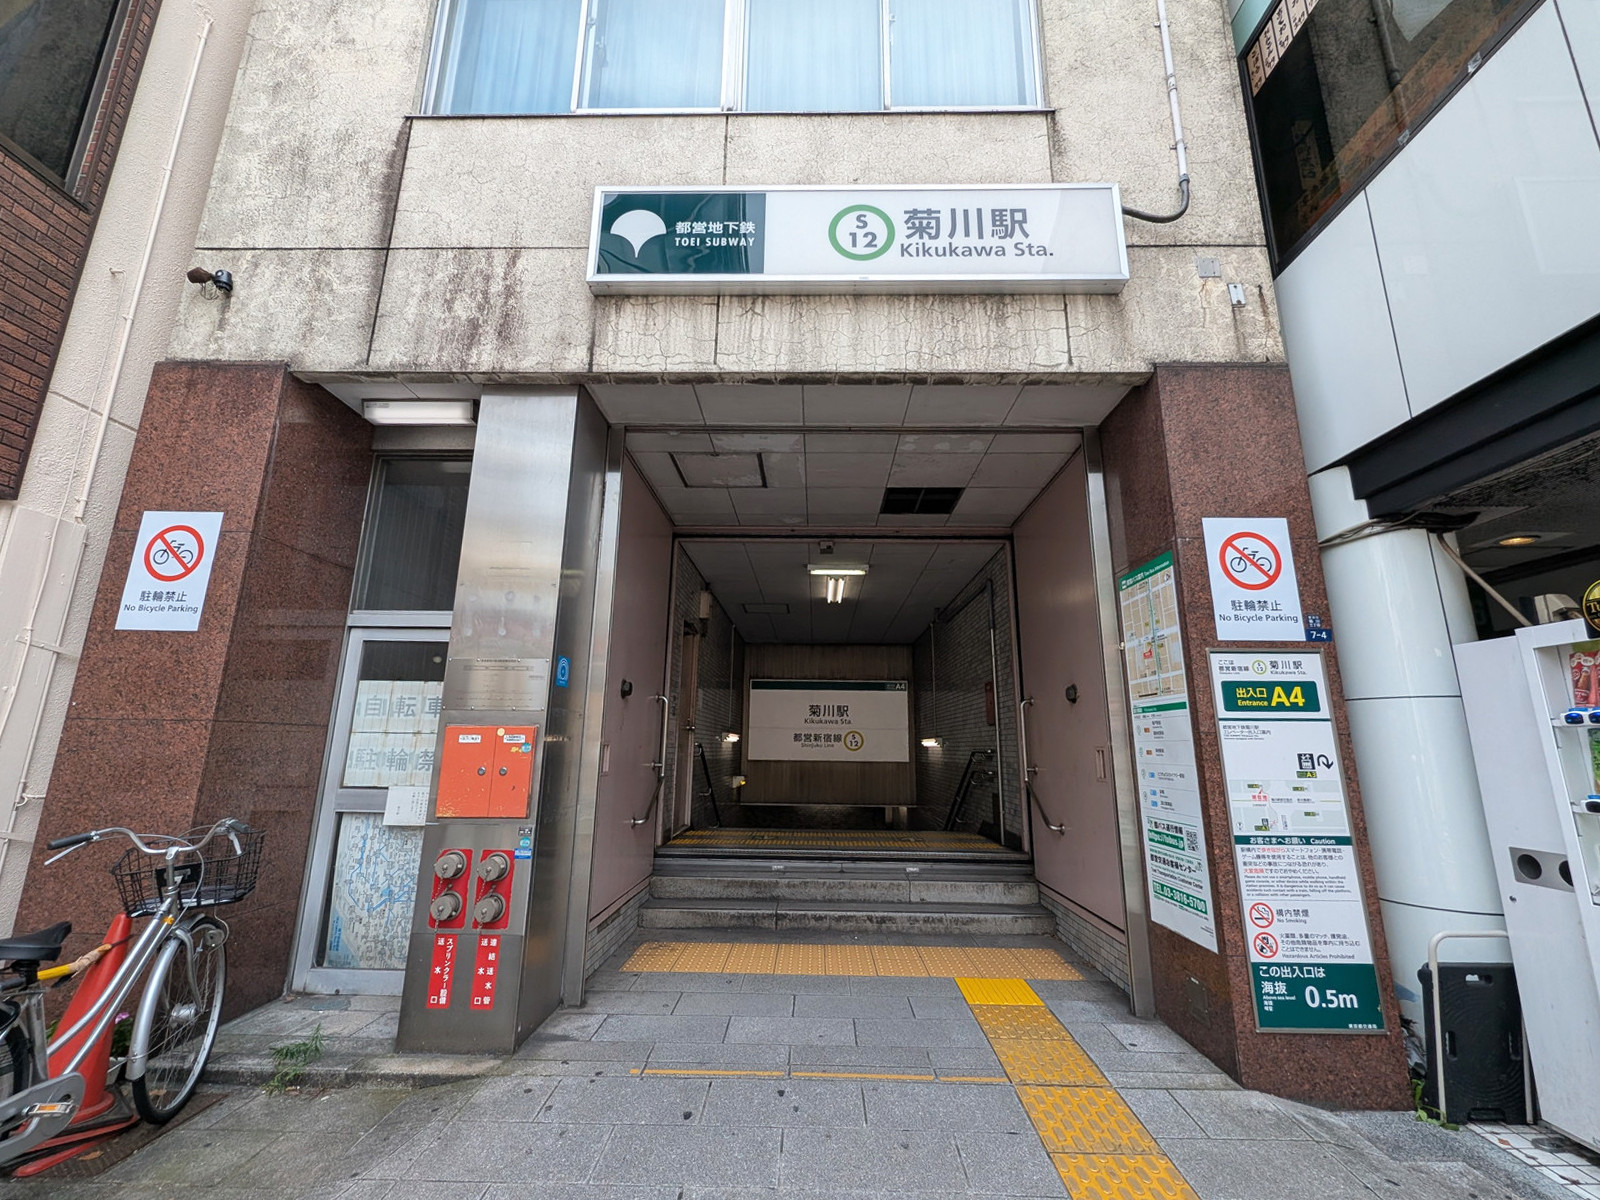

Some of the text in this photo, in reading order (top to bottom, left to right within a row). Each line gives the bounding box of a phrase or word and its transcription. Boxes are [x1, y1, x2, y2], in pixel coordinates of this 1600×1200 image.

[675, 221, 756, 234] 都営地下鉄
[856, 214, 868, 230] S
[904, 208, 1030, 240] 菊川駅
[674, 237, 756, 247] TOEI SUBWAY
[849, 232, 878, 248] 12
[900, 242, 1054, 258] Kikukawa Sta.
[139, 590, 188, 602] 駐輪禁止
[138, 604, 166, 614] Bicycle
[168, 604, 198, 614] Parking
[1230, 600, 1282, 612] 駐輪禁止
[1234, 614, 1263, 623] Bicycle
[1266, 614, 1298, 624] Parking
[1310, 630, 1328, 639] 7-4
[1269, 660, 1303, 670] 菊川駅
[1236, 687, 1267, 698] 出入口
[1270, 686, 1306, 707] A4
[364, 695, 442, 718] 自転車
[808, 704, 850, 718] 菊川駅
[793, 732, 843, 742] 都営新宿線
[353, 748, 435, 772] 駐輪禁
[1276, 908, 1310, 917] 構内禁煙
[430, 937, 445, 1004] 送水口
[439, 938, 454, 1005] スプリンクラー設備
[474, 938, 488, 1005] 送水口
[482, 938, 498, 1005] 連結送水管
[1259, 966, 1326, 978] この出入口は
[1261, 981, 1288, 995] 海抜
[1305, 985, 1358, 1008] 0.5m
